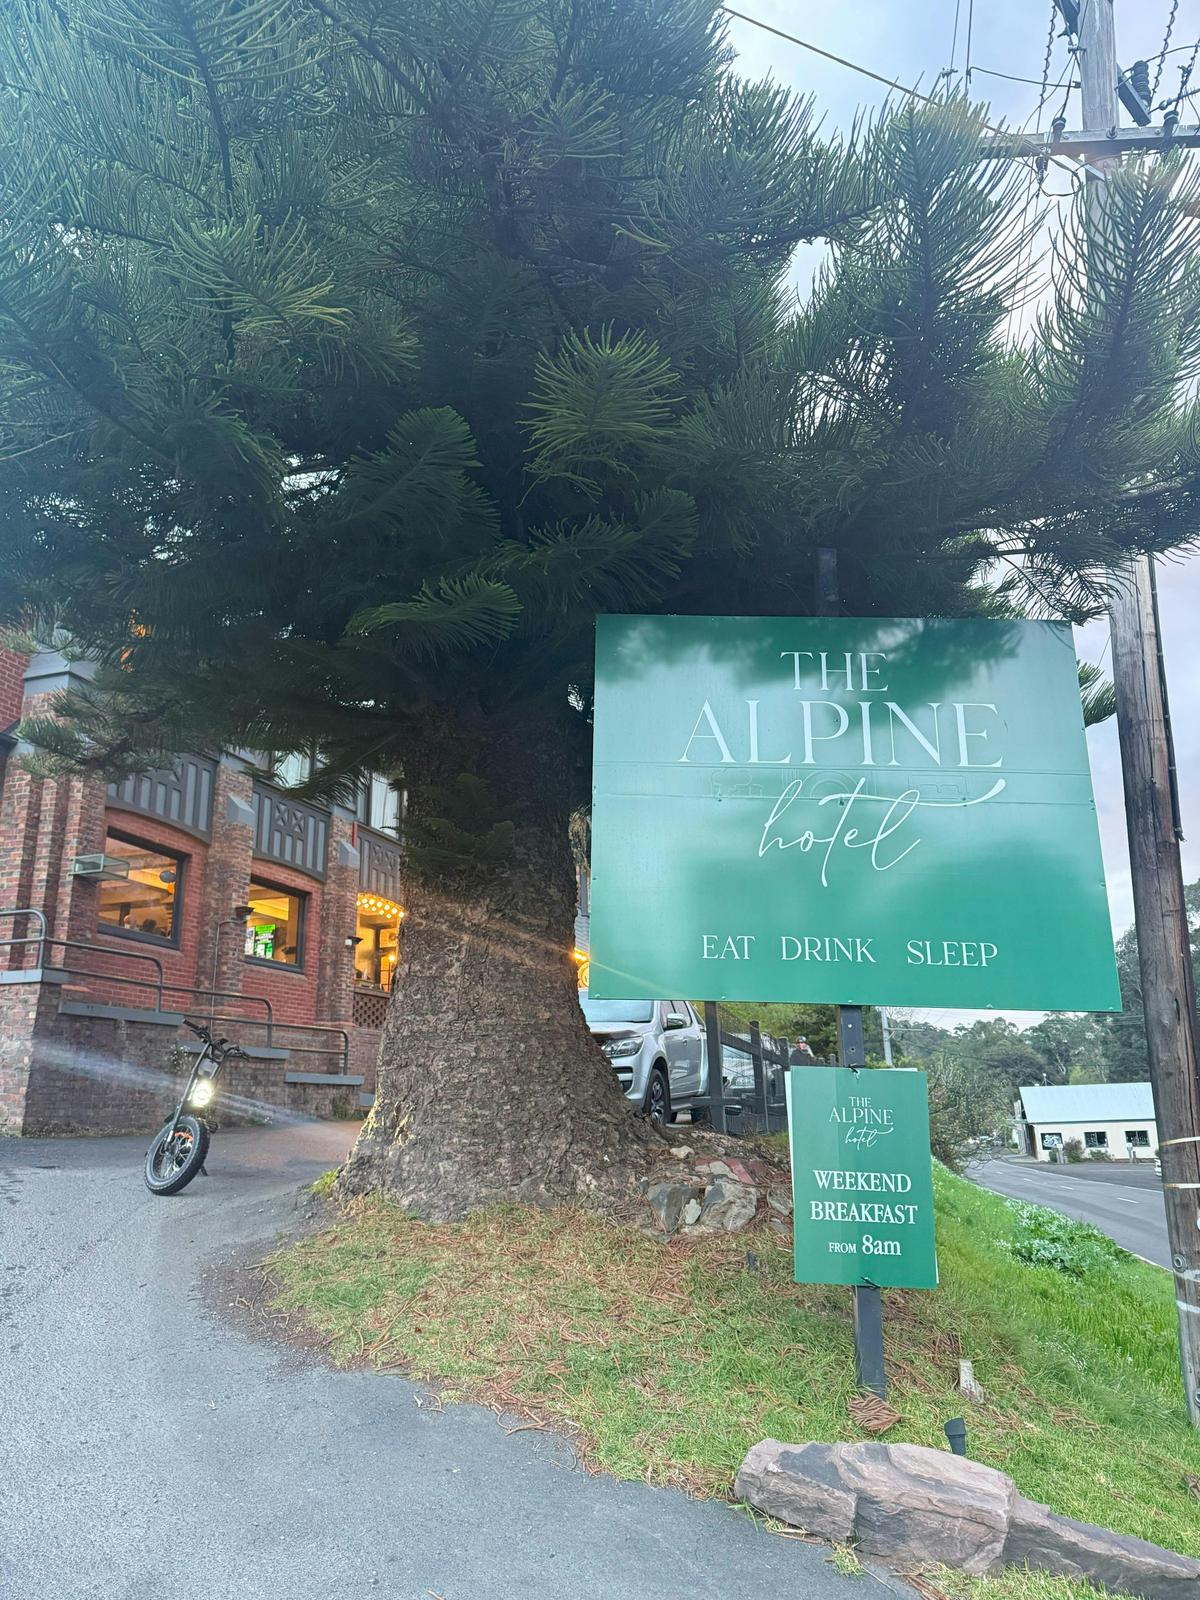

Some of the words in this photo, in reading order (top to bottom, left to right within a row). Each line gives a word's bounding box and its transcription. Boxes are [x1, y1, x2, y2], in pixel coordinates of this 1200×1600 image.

[780, 651, 888, 692] THE
[677, 699, 1004, 768] ALPINE
[758, 777, 1006, 888] hotel
[702, 935, 756, 960] EAT
[780, 936, 877, 963] DRINK
[907, 940, 998, 967] SLEEP
[848, 1096, 871, 1107] THE
[828, 1107, 894, 1125] ALPINE
[845, 1126, 894, 1151] hotel
[812, 1169, 912, 1193] WEEKEND
[809, 1200, 918, 1225] BREAKFAST
[828, 1242, 857, 1254] FROM
[862, 1234, 902, 1256] 8am
